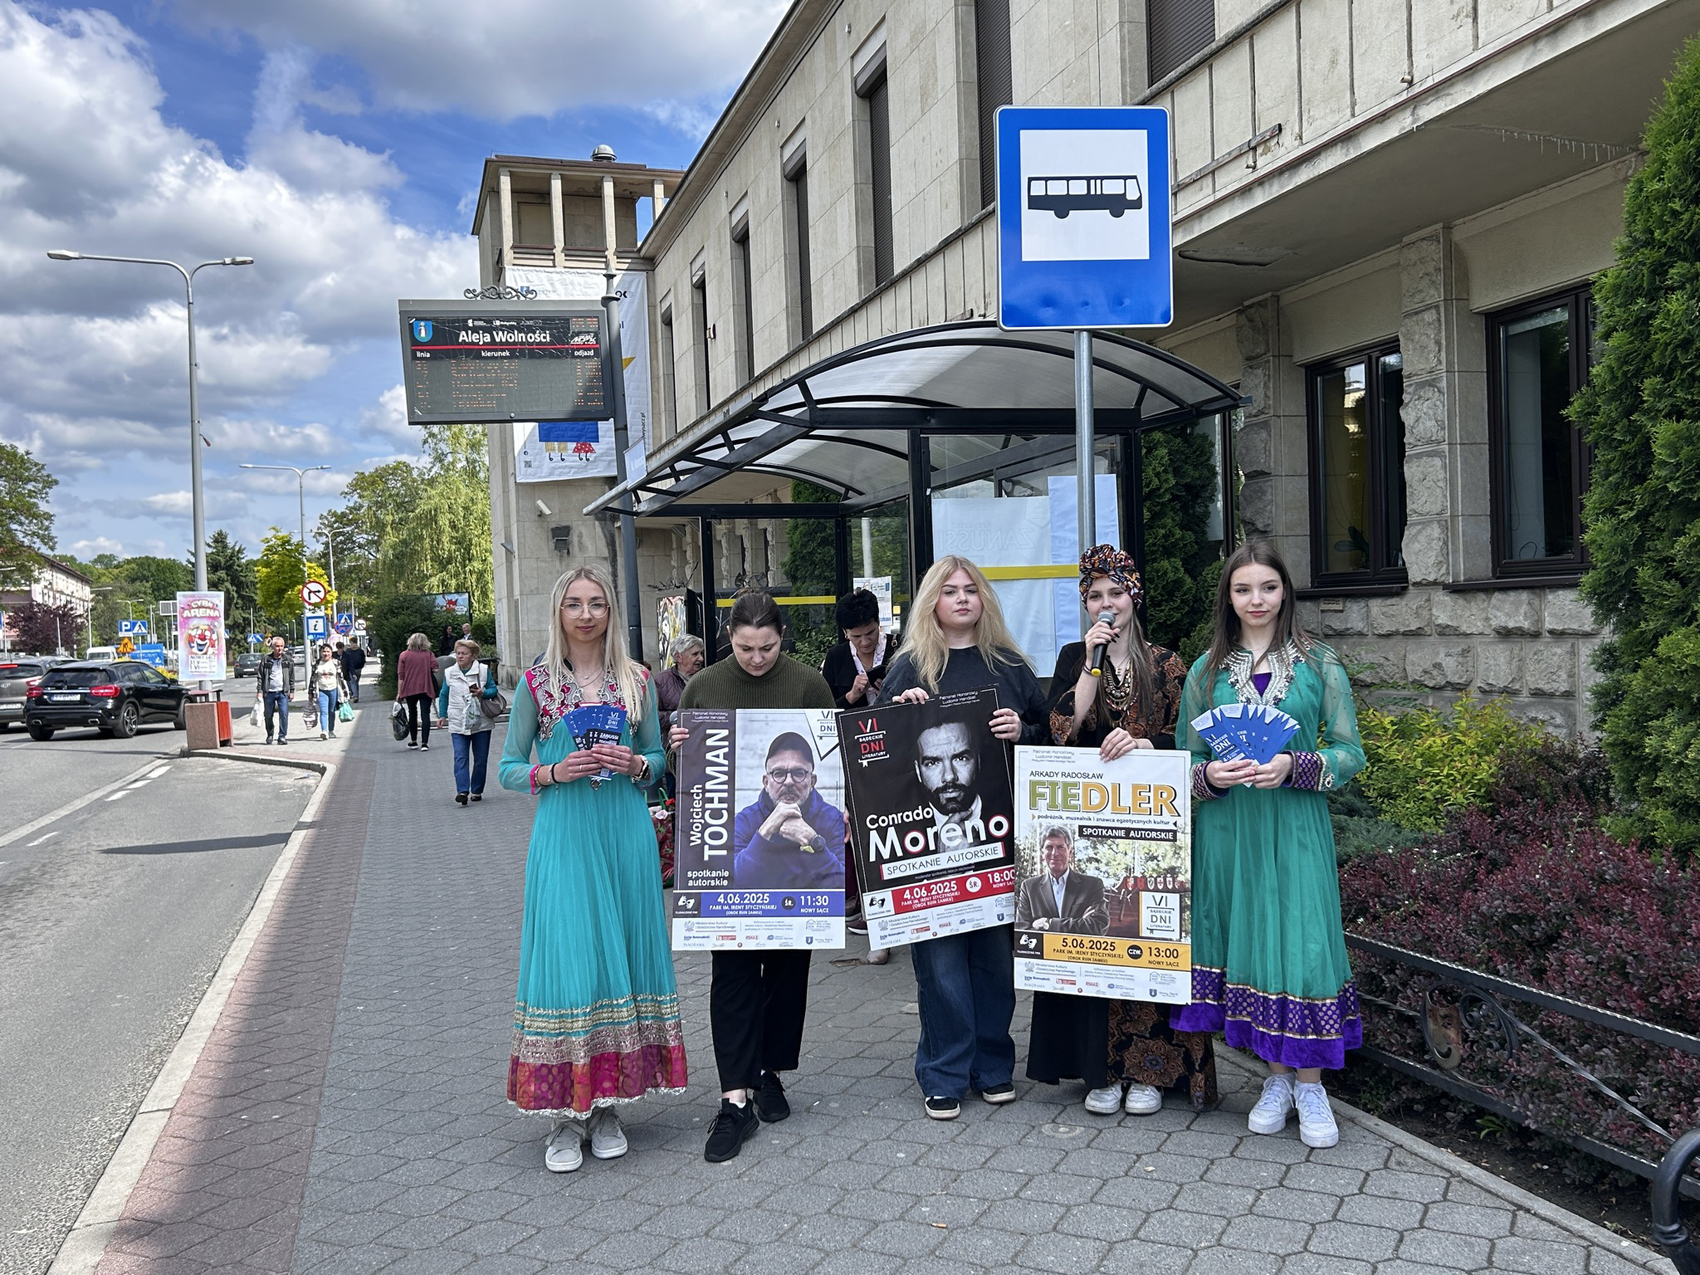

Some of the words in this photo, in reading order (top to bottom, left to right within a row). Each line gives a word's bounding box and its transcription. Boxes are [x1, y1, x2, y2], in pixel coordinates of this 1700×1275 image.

[459, 330, 490, 345] Aleja
[493, 330, 550, 342] Wolności
[574, 349, 594, 357] odjazd
[183, 609, 220, 618] ARENA
[122, 622, 130, 632] P
[821, 710, 833, 719] VI
[859, 717, 877, 732] VI
[860, 740, 884, 754] DNI
[1214, 738, 1231, 752] DNI
[704, 729, 729, 861] TOCHMAN
[1029, 780, 1181, 817] FIEDLER
[690, 784, 704, 846] Wojciech
[866, 806, 932, 829] Conrado
[869, 814, 1009, 862] Moreno
[1083, 827, 1125, 837] SPOTKANIE
[1129, 830, 1173, 840] AUTORSKIE
[887, 857, 941, 875] SPOTKANIE
[946, 847, 998, 864] AUTORSKIE
[687, 869, 729, 878] spotkanie
[688, 878, 728, 886] autorskie
[904, 881, 957, 900] 4.06.2025
[969, 880, 980, 889] ŚR.
[987, 870, 1015, 884] 18:00
[717, 894, 770, 904] 4.06.2025
[800, 896, 828, 906] 11:30
[1152, 895, 1167, 907] VI
[1151, 914, 1171, 924] DNI
[1061, 938, 1116, 951] 5.06.2025
[1148, 946, 1179, 959] 13:00
[1090, 950, 1124, 959] STYCZYŃSKIEJ
